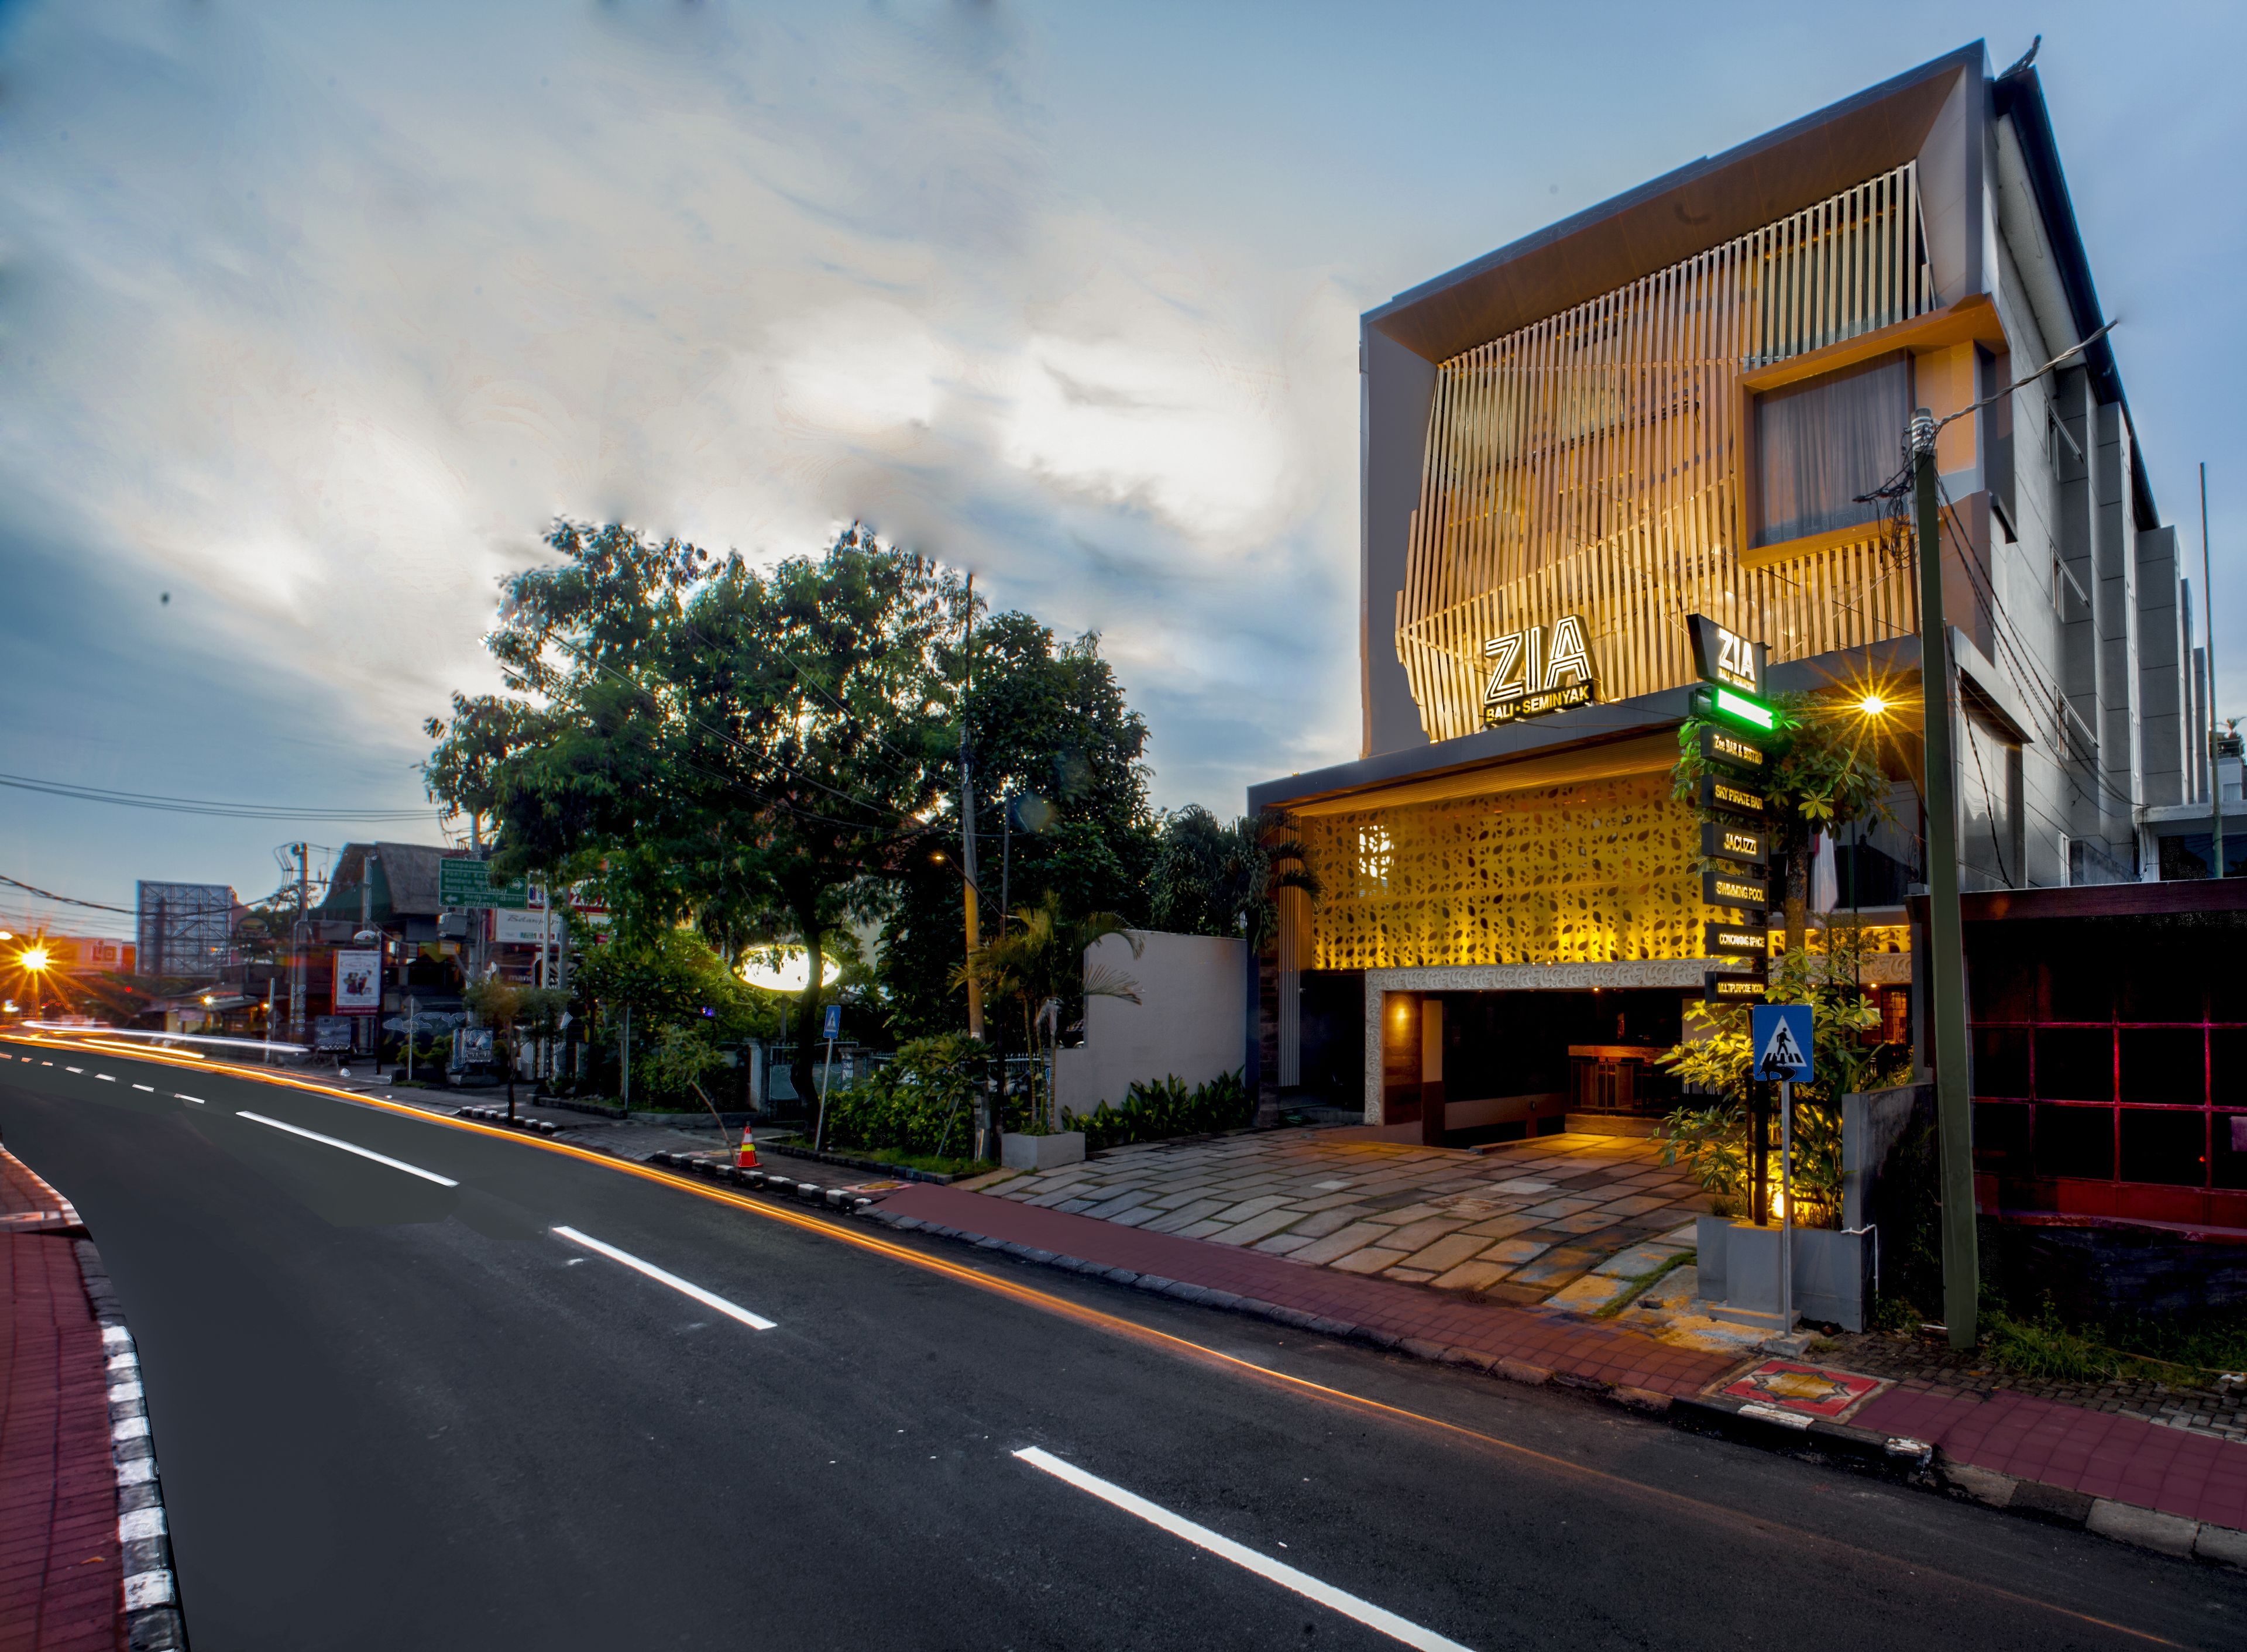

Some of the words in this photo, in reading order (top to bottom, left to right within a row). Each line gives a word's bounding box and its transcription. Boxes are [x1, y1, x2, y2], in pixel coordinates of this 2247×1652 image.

[1484, 615, 1592, 705] ZIA
[1719, 627, 1755, 682] ZIA
[1486, 702, 1514, 722] BALI
[1523, 685, 1590, 714] SEMINYAK
[1726, 739, 1737, 755] BAR
[1743, 746, 1763, 765] BISTRO
[1715, 785, 1728, 799] SKY
[1729, 789, 1750, 807] PIRATE
[1751, 798, 1763, 810] BAR
[1724, 833, 1757, 855] JACUZZI
[1716, 881, 1748, 898] SWIMMING
[1748, 888, 1764, 902] POOL
[1749, 936, 1765, 947] SPACE
[1717, 983, 1751, 993] MULTIPURPOSE
[1751, 983, 1764, 994] ROOM
